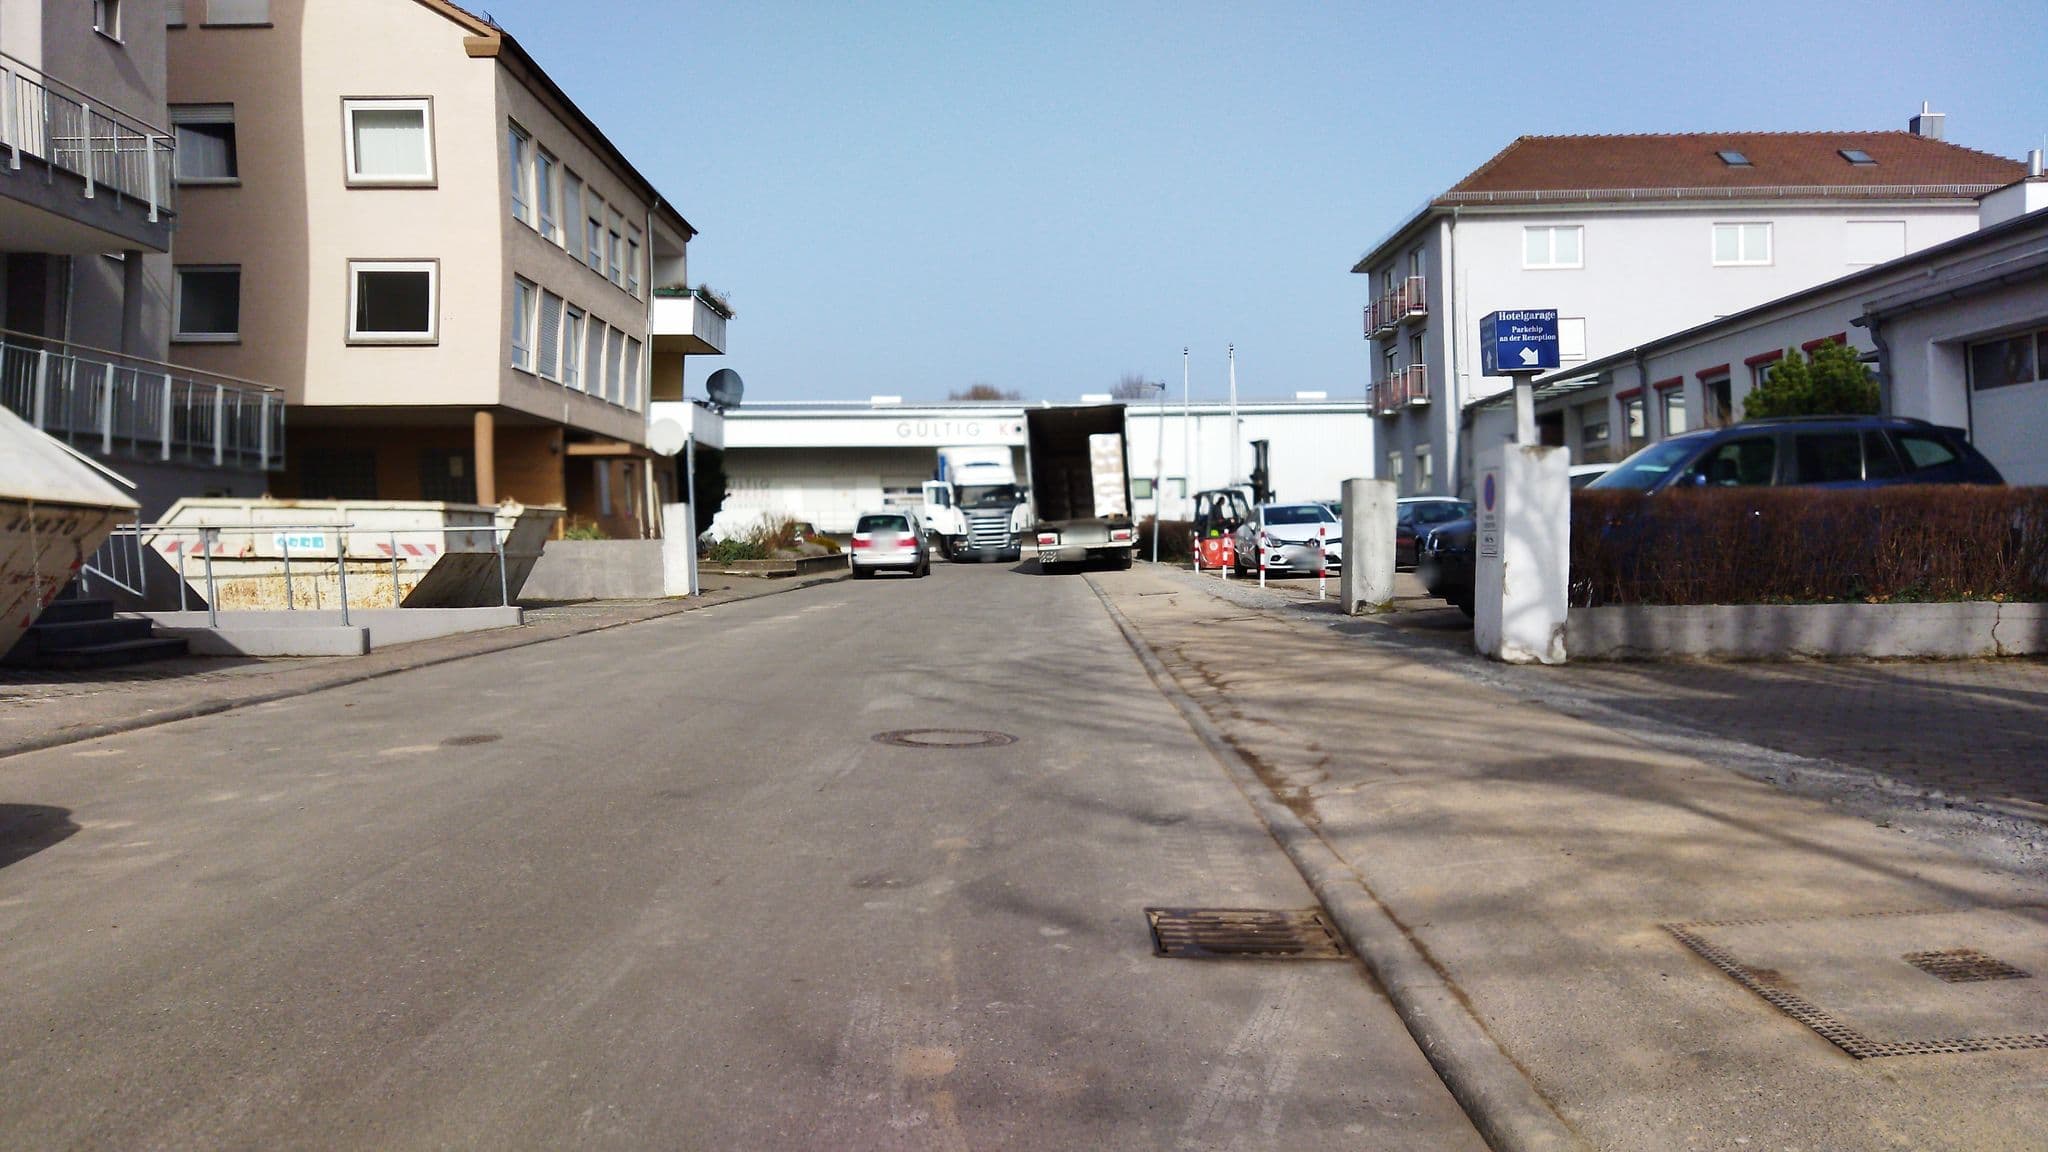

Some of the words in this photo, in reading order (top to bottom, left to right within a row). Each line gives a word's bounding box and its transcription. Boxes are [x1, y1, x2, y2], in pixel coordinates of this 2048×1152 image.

[1498, 311, 1556, 321] Hotelgarage
[1511, 325, 1544, 334] Parkchip
[1509, 334, 1521, 342] der
[1522, 333, 1557, 343] Rezeption
